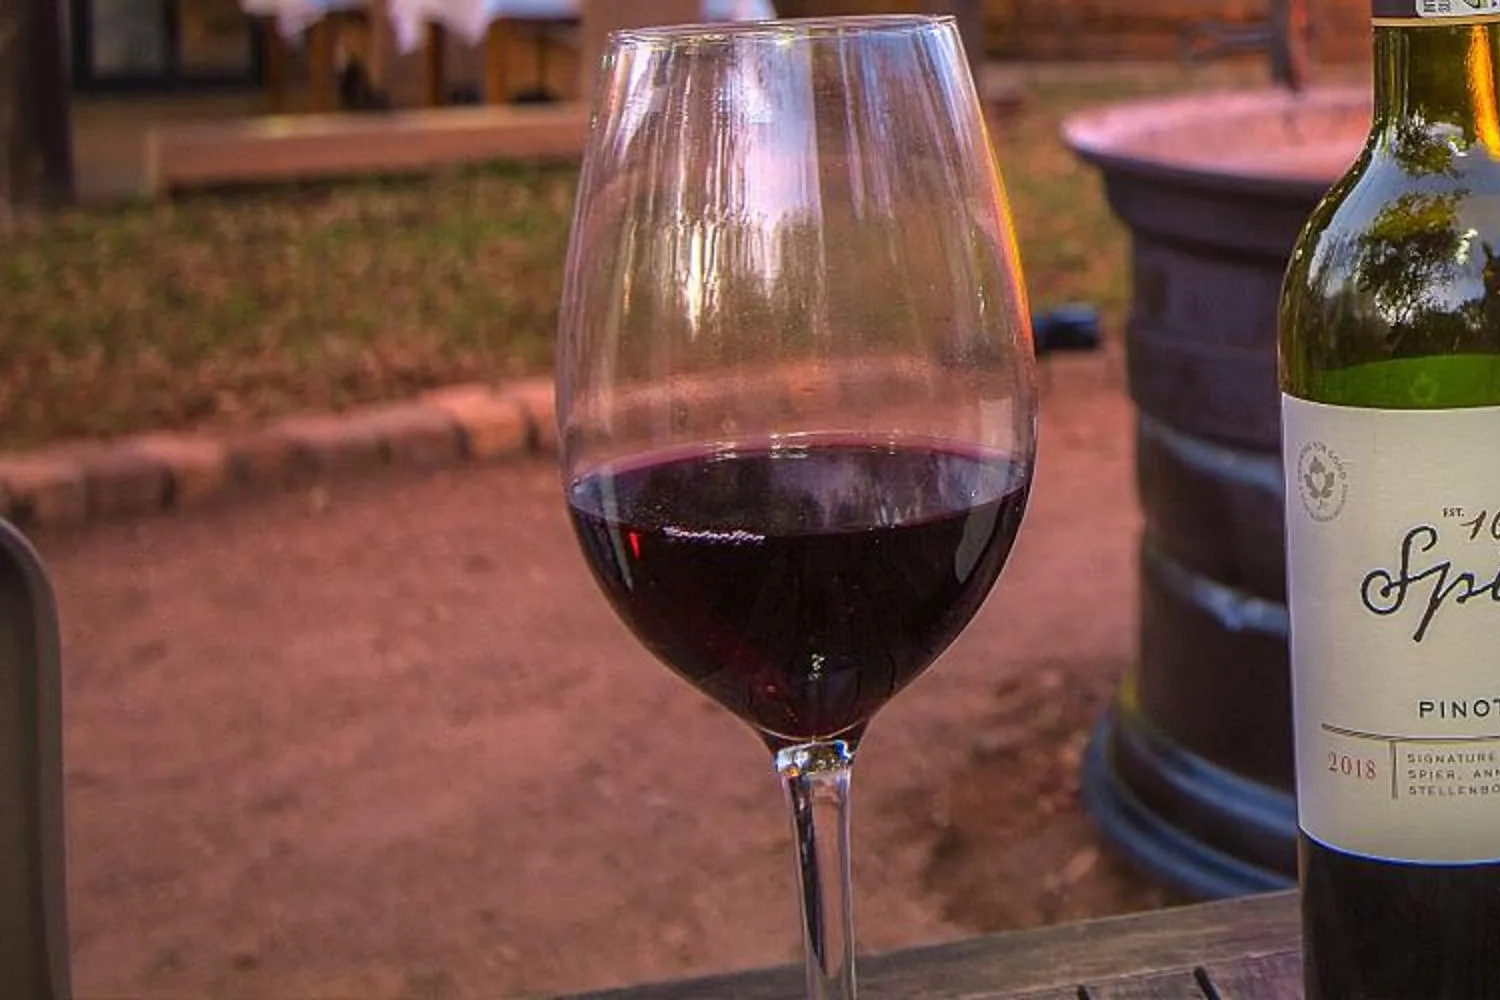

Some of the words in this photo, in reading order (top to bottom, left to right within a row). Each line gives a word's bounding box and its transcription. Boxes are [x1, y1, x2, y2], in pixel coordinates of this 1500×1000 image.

[1443, 507, 1465, 518] EST.
[1407, 752, 1494, 764] SIGNATURE
[1328, 750, 1377, 780] 2018
[1407, 769, 1462, 781] SPIER,
